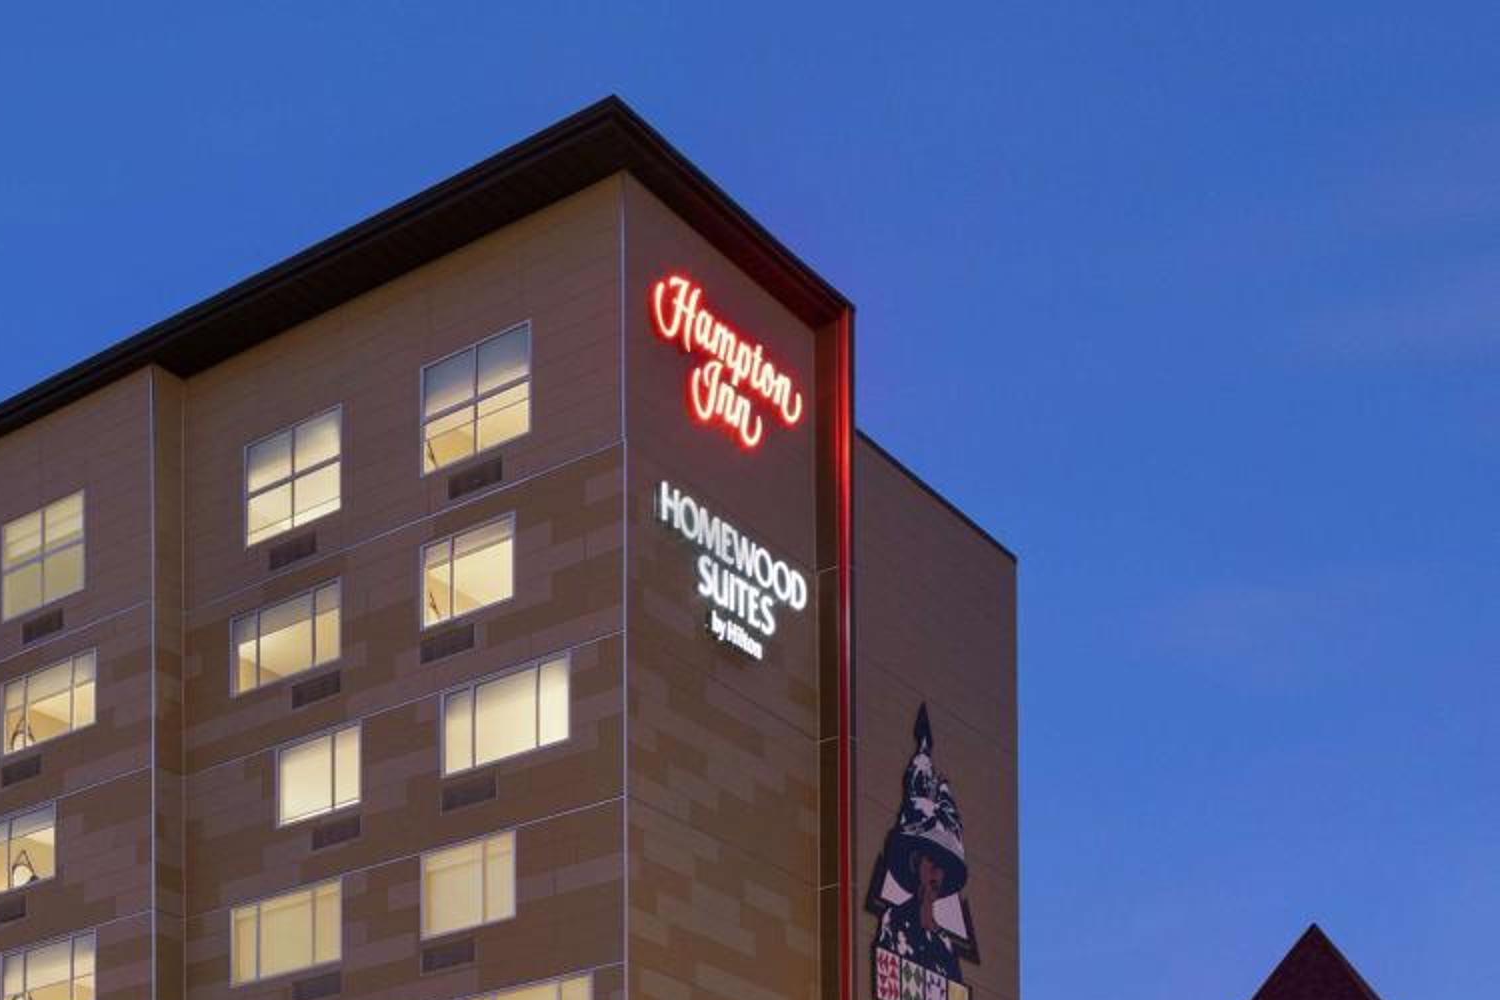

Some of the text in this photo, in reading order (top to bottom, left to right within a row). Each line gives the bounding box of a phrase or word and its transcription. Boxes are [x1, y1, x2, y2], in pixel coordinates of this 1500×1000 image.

[655, 276, 802, 423] Hampton
[692, 361, 762, 446] Inn
[661, 480, 807, 611] HOMEWOOD
[698, 554, 775, 635] SUITES
[711, 610, 762, 660] by Hilton
